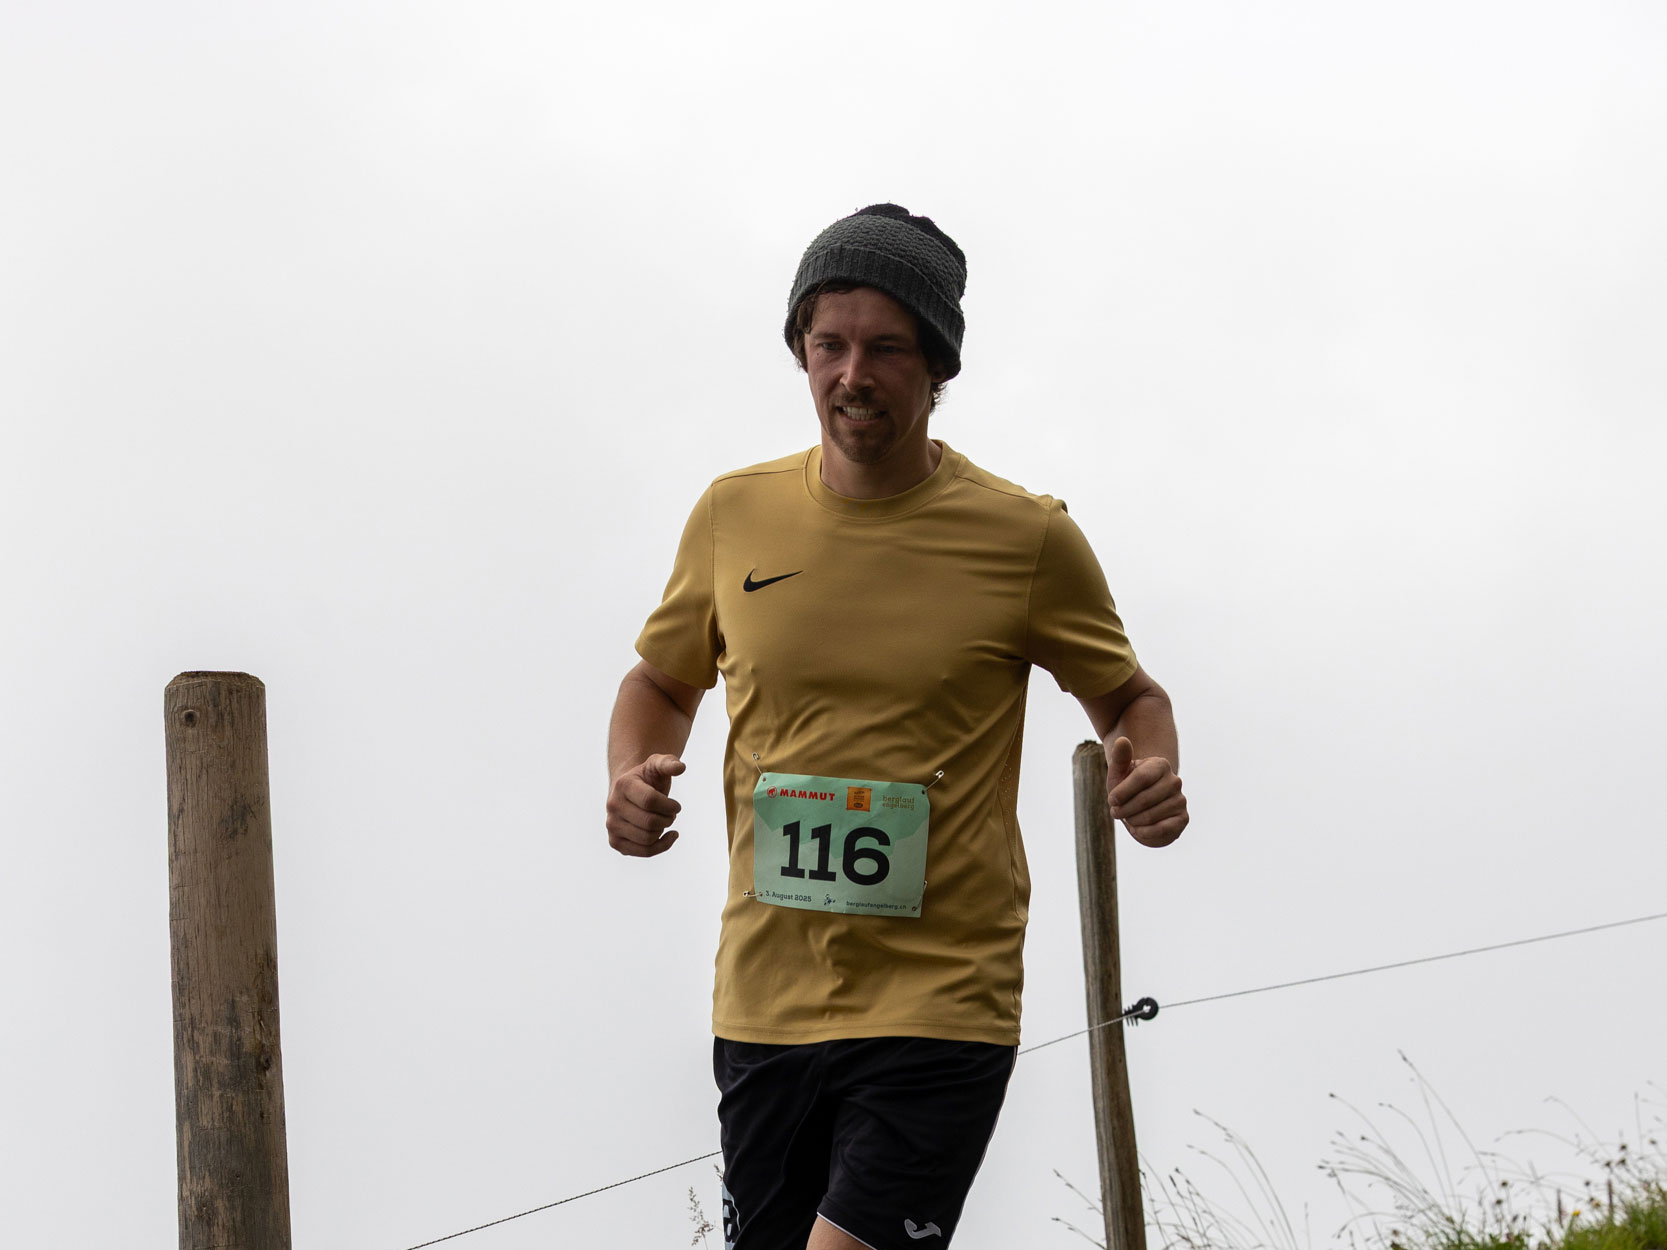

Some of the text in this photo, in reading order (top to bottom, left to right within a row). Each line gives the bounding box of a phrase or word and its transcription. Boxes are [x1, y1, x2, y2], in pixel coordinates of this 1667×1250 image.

[780, 788, 835, 801] MAMMUT
[780, 820, 891, 886] 116
[772, 891, 793, 901] August
[795, 895, 812, 903] 2025
